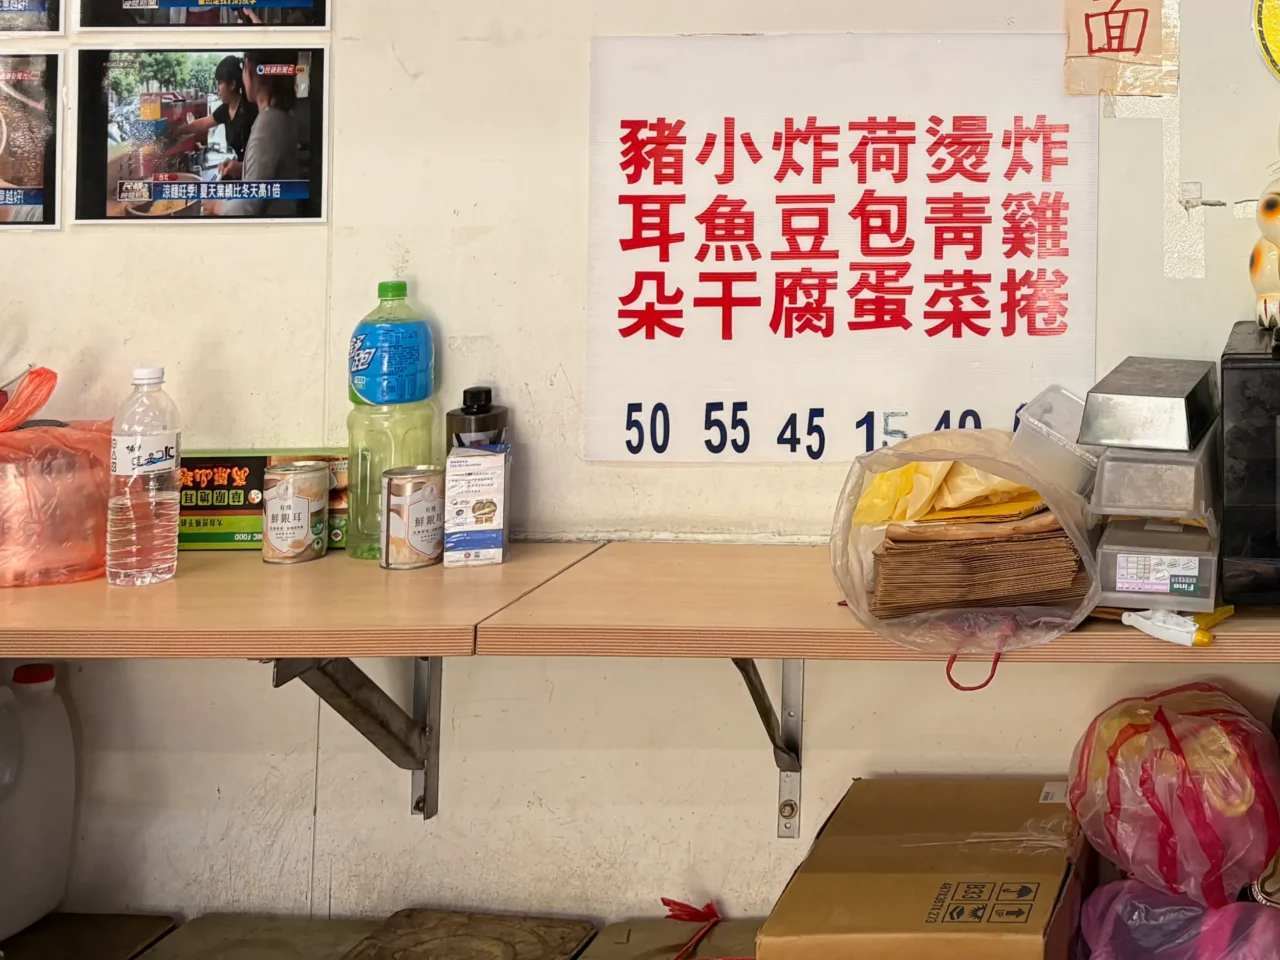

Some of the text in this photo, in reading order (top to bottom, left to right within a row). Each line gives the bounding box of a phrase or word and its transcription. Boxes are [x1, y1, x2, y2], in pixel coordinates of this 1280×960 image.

[617, 118, 686, 339] 豬耳朵
[693, 117, 763, 339] 小魚干
[769, 116, 840, 338] 炸豆腐
[847, 116, 916, 332] 荷包蛋
[923, 115, 993, 338] 燙青菜
[1000, 115, 1070, 337] 炸雞捲
[184, 491, 241, 503] 草原地耳
[271, 512, 302, 523] 鮮銀耳
[625, 402, 670, 454] 50
[704, 401, 750, 454] 55
[777, 408, 825, 460] 45
[1173, 583, 1194, 591] Fine
[961, 884, 986, 899] B33
